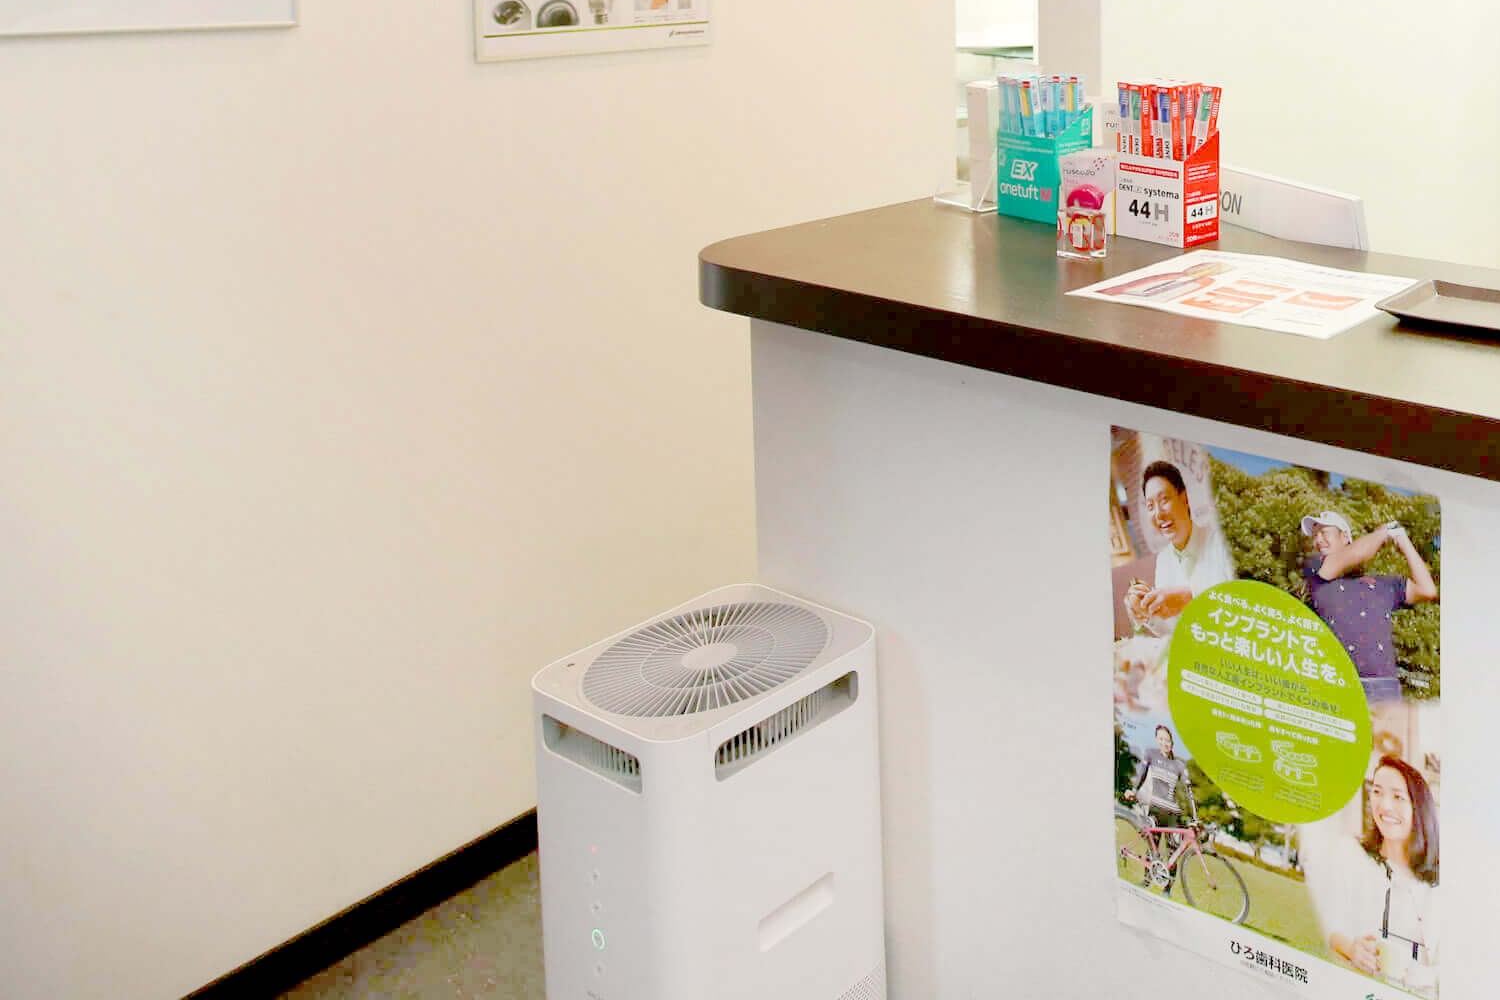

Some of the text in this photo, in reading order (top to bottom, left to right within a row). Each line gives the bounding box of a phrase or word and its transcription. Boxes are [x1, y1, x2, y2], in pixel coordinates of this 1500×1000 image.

[1010, 159, 1039, 182] EX
[1000, 181, 1039, 200] onetuft
[1143, 187, 1180, 200] systema
[1128, 199, 1170, 222] 44 H
[1191, 207, 1204, 218] 44
[1219, 190, 1243, 216] ON
[1208, 607, 1325, 657] インプラントで、
[1190, 622, 1347, 688] もっと楽しい人生を。
[1229, 940, 1309, 984] ひろ歯科医院
